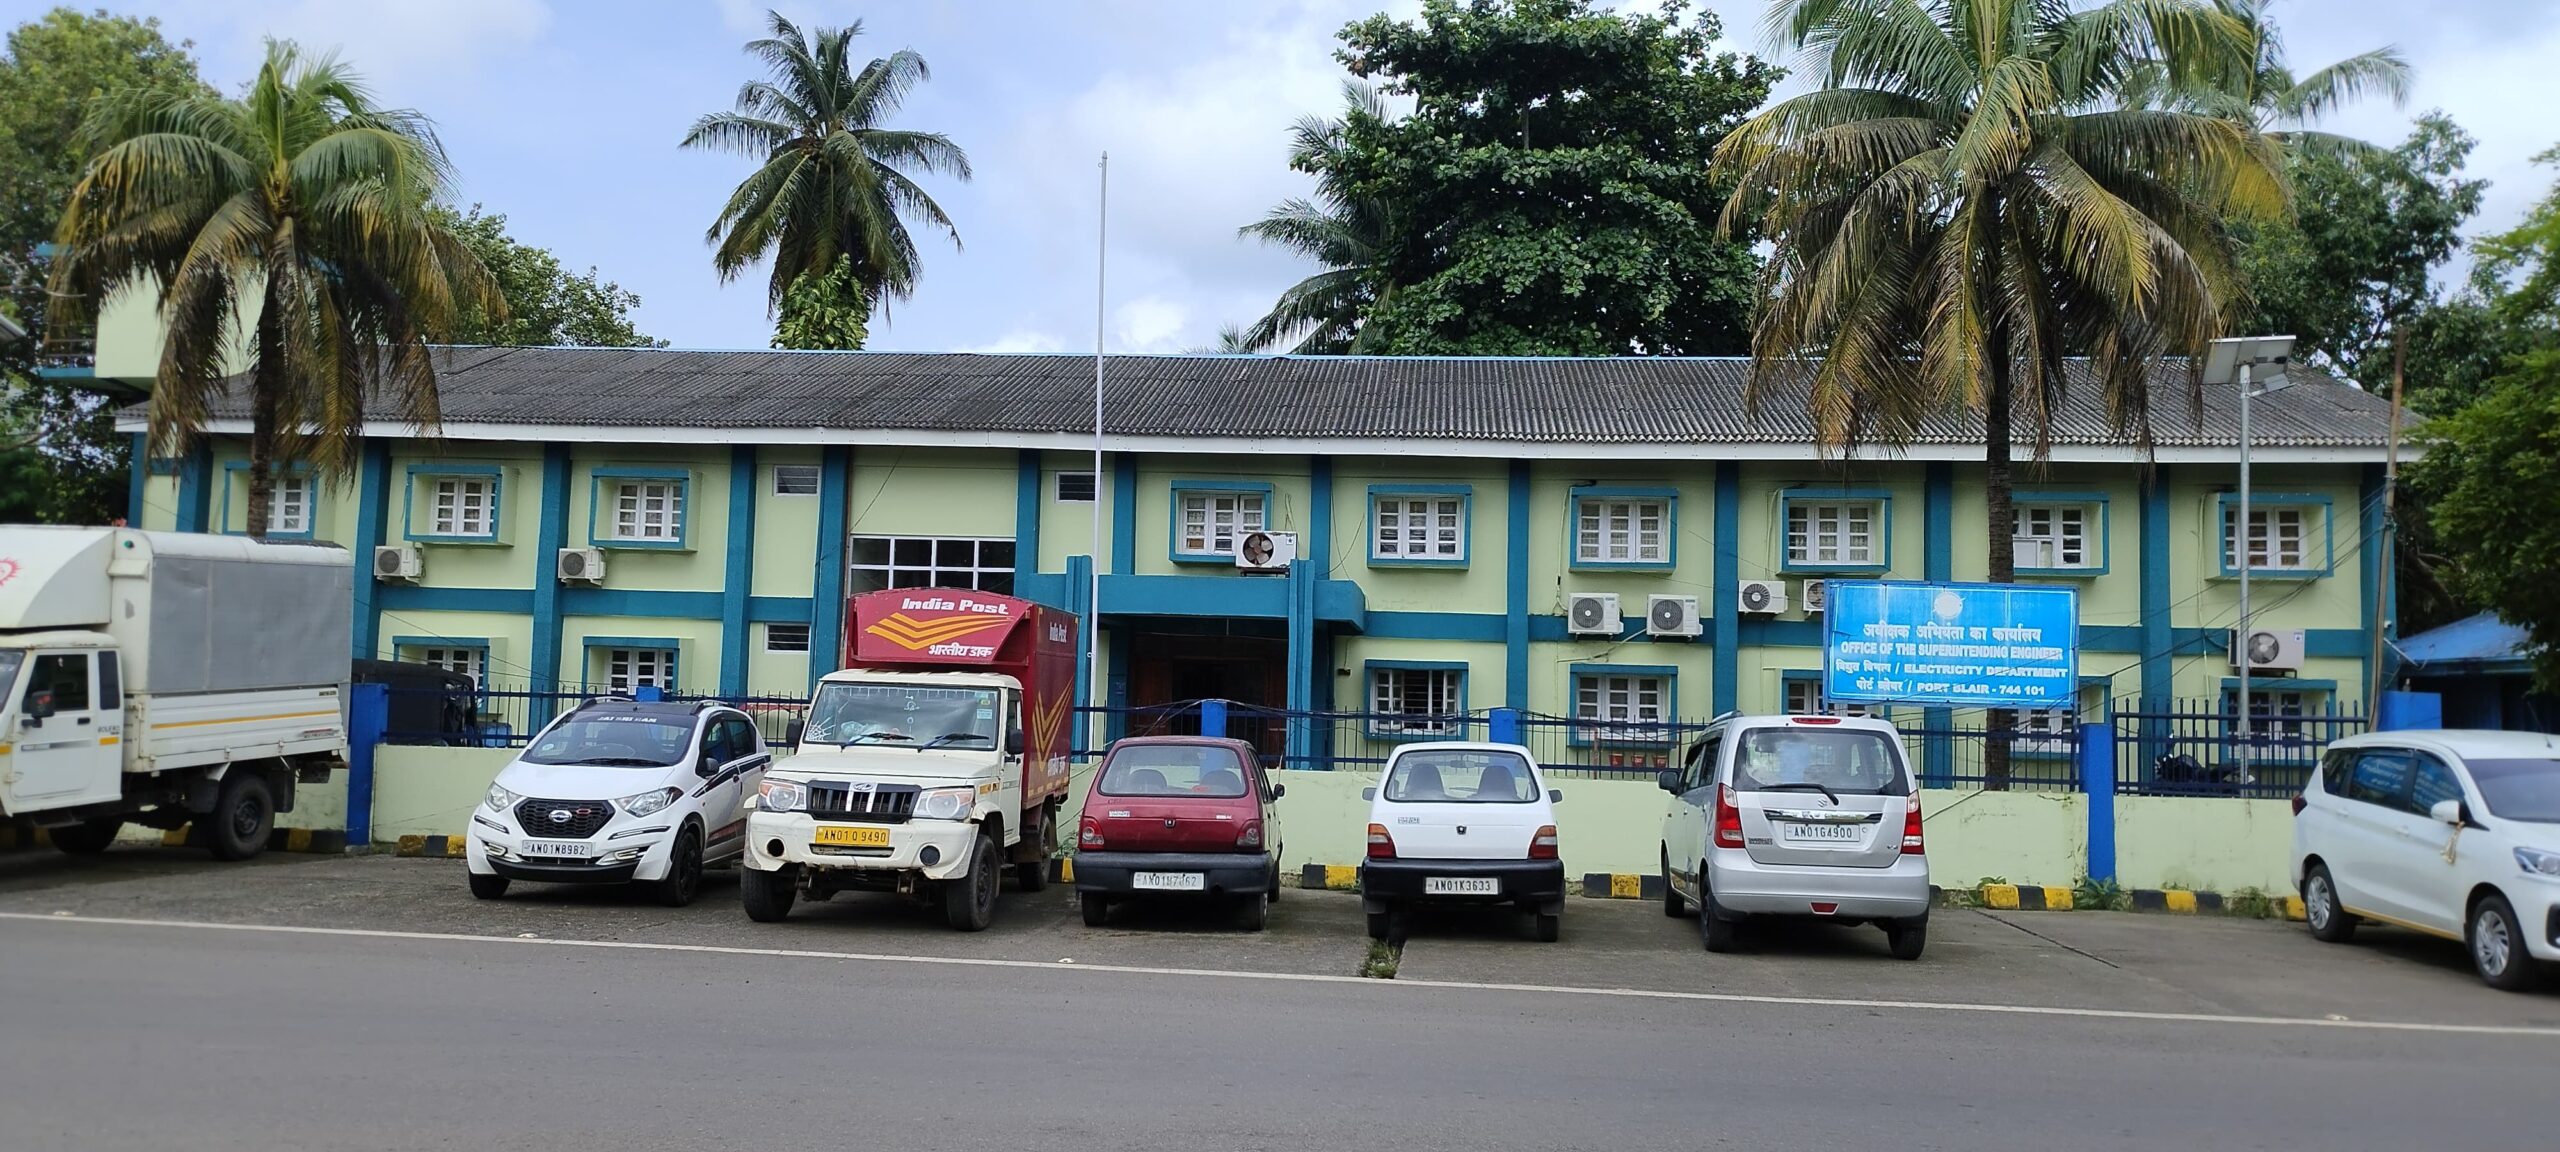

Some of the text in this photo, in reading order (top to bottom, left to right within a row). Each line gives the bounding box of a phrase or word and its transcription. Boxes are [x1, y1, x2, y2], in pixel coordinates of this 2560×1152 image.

[902, 598, 1009, 615] India Post
[1916, 621, 1965, 641] अभियंता
[1969, 627, 1987, 642] का
[1992, 622, 2042, 642] कार्यालय
[928, 642, 995, 657] भारतीय डाक
[1841, 641, 2063, 660] OFFICE OF THE SUPERINTENDING ENGINEER
[1904, 664, 1983, 676] ELECTRICITY
[1986, 666, 2068, 678] DEPARTMENT
[1917, 682, 1950, 693] PORT
[1952, 683, 1989, 694] BLAIR
[1999, 685, 2021, 695] 744
[2024, 686, 2045, 695] 101
[861, 831, 887, 843] 9490
[1794, 826, 1852, 838] AN01G4900
[1434, 880, 1491, 892] AN01K3633
